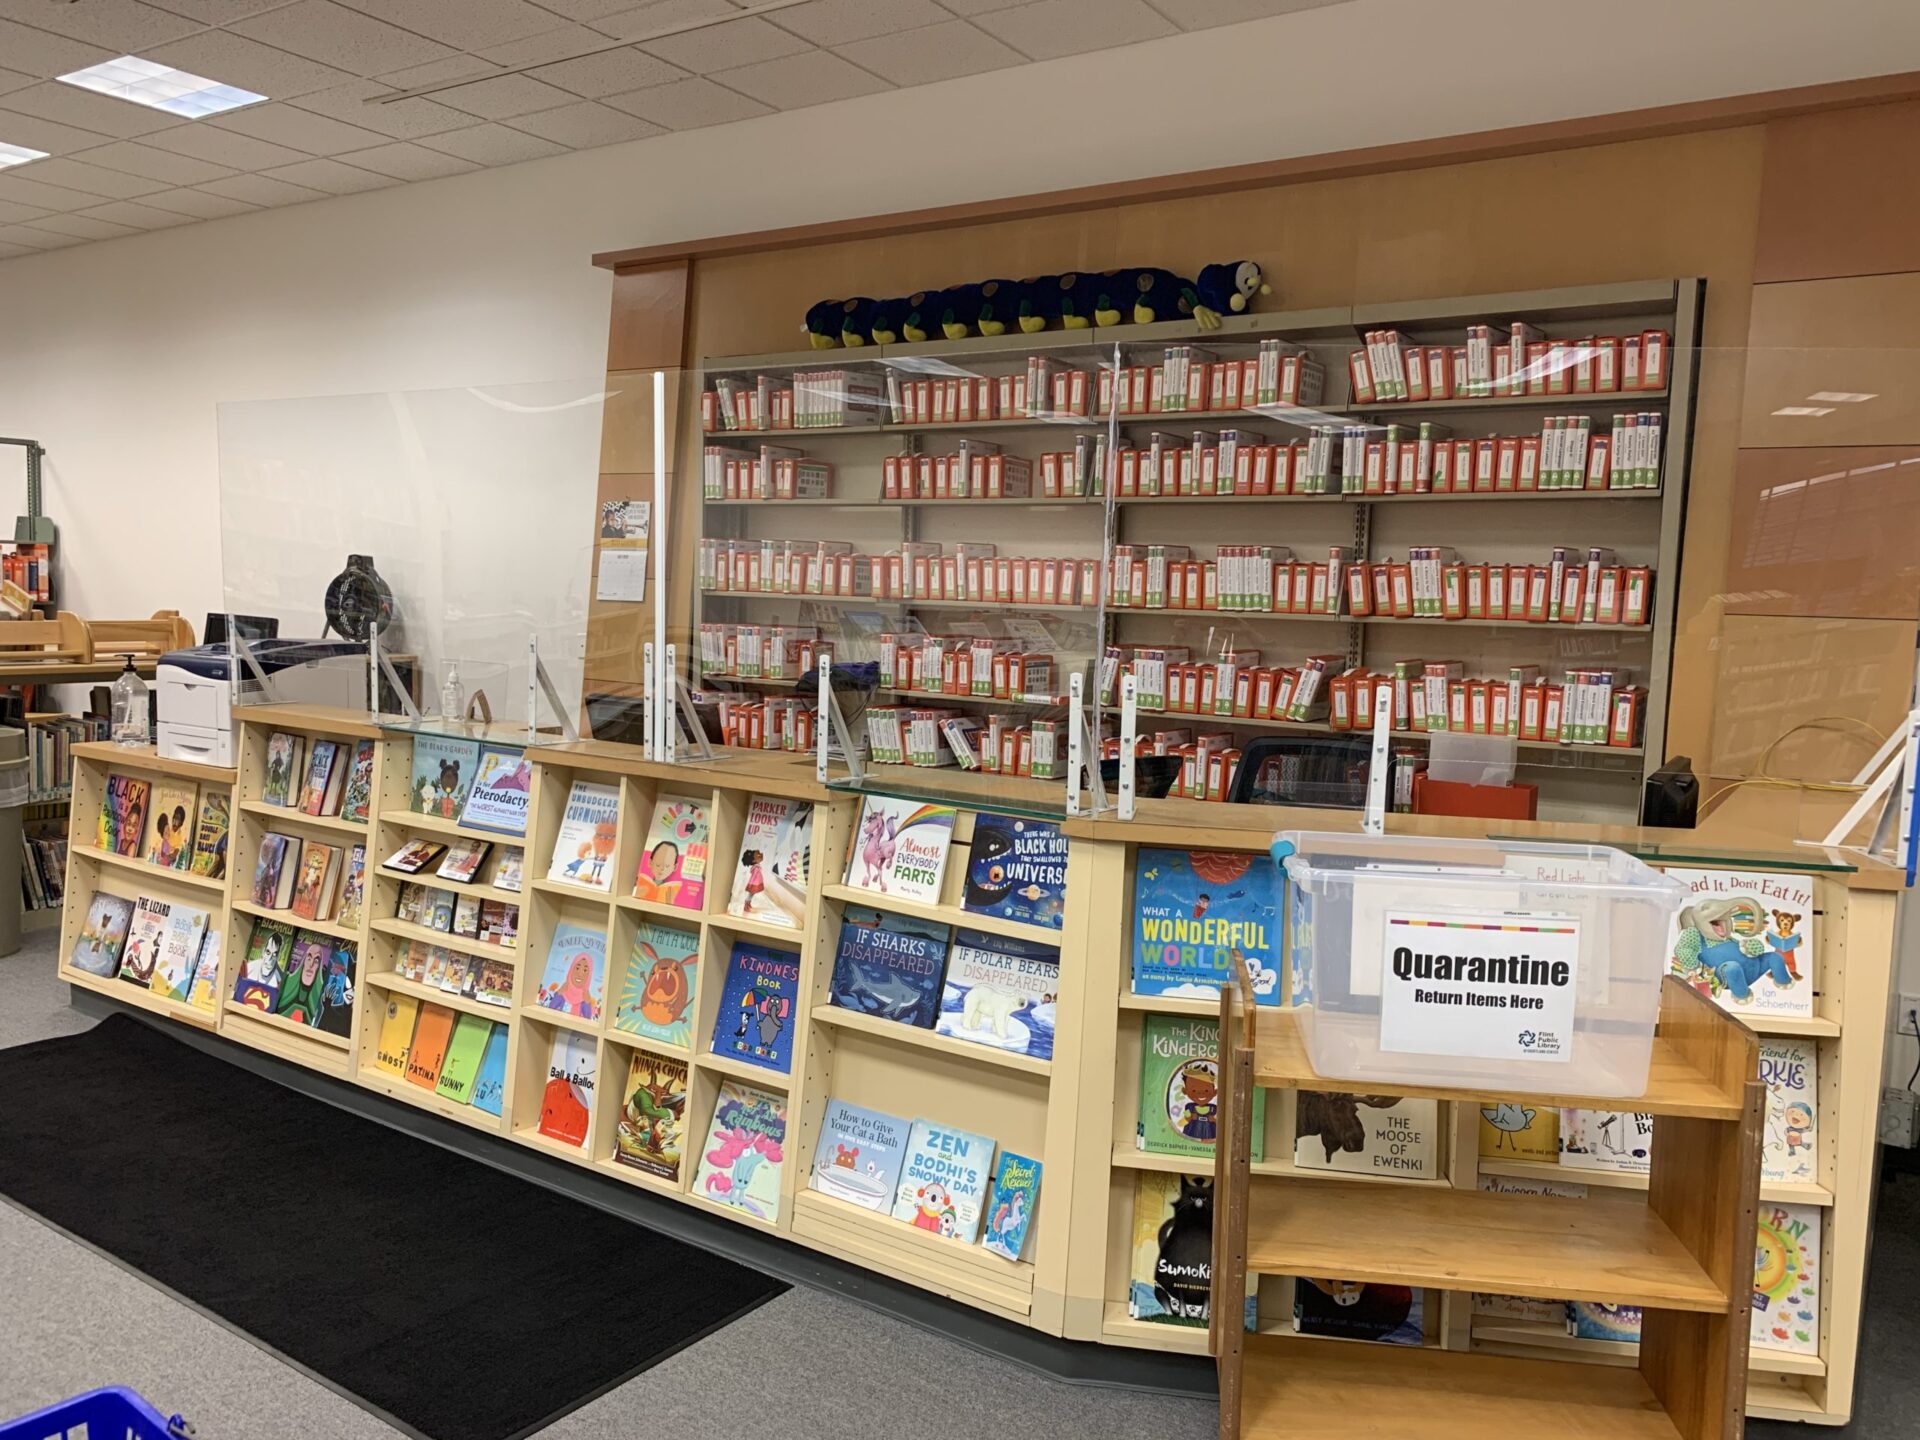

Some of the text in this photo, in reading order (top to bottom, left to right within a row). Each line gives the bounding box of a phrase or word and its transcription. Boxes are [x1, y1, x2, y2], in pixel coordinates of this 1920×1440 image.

[108, 776, 144, 804] BLACK
[575, 784, 587, 792] THE
[473, 786, 529, 810] Pterodacty
[752, 801, 787, 816] PARKER
[750, 812, 778, 827] LOOKS
[748, 825, 760, 836] UP
[901, 837, 941, 859] Almost
[1014, 839, 1046, 855] BLACK
[897, 852, 940, 870] EVERYBODY
[894, 865, 936, 886] FARTS
[1538, 866, 1558, 881] Red
[1730, 877, 1758, 890] Don't
[1760, 879, 1790, 900] Eat
[1792, 890, 1812, 906] It!
[138, 897, 148, 911] THE
[149, 900, 170, 917] LIZARD
[1142, 906, 1182, 918] WHAT A
[856, 929, 926, 956] IF SHARKS
[1142, 918, 1270, 950] WONDERFUL
[842, 942, 934, 975] DISAPPEARED
[959, 948, 1060, 979] IF POLAR BEARS
[1141, 943, 1230, 970] WORLD
[1393, 947, 1570, 986] Quarantine
[964, 964, 1048, 993] DISAPPEARED
[1166, 974, 1174, 982] by
[1415, 989, 1544, 1010] Return Items Here
[1762, 988, 1776, 997] Ian
[1756, 997, 1809, 1011] Schoenherr
[1171, 1027, 1186, 1038] The
[378, 1050, 404, 1069] GHOST
[1790, 1048, 1806, 1062] for
[408, 1063, 436, 1083] PATINA
[632, 1056, 660, 1074] NINJA
[550, 1067, 564, 1079] Ball
[564, 1073, 571, 1082] &
[440, 1076, 464, 1093] SUNNY
[476, 1088, 485, 1100] LU
[725, 1110, 784, 1137] Rainbows
[840, 1109, 894, 1134] How to Give
[1387, 1116, 1410, 1130] THE
[830, 1118, 850, 1133] Your
[852, 1125, 866, 1138] Cat
[876, 1132, 898, 1148] Bath
[1376, 1130, 1421, 1144] MOOSE
[926, 1130, 970, 1158] ZEN
[1390, 1144, 1406, 1156] OF
[938, 1151, 953, 1162] and
[1374, 1156, 1423, 1171] EWENKI
[914, 1152, 978, 1184] BODHI'S
[908, 1166, 978, 1197] SNOWY DAY
